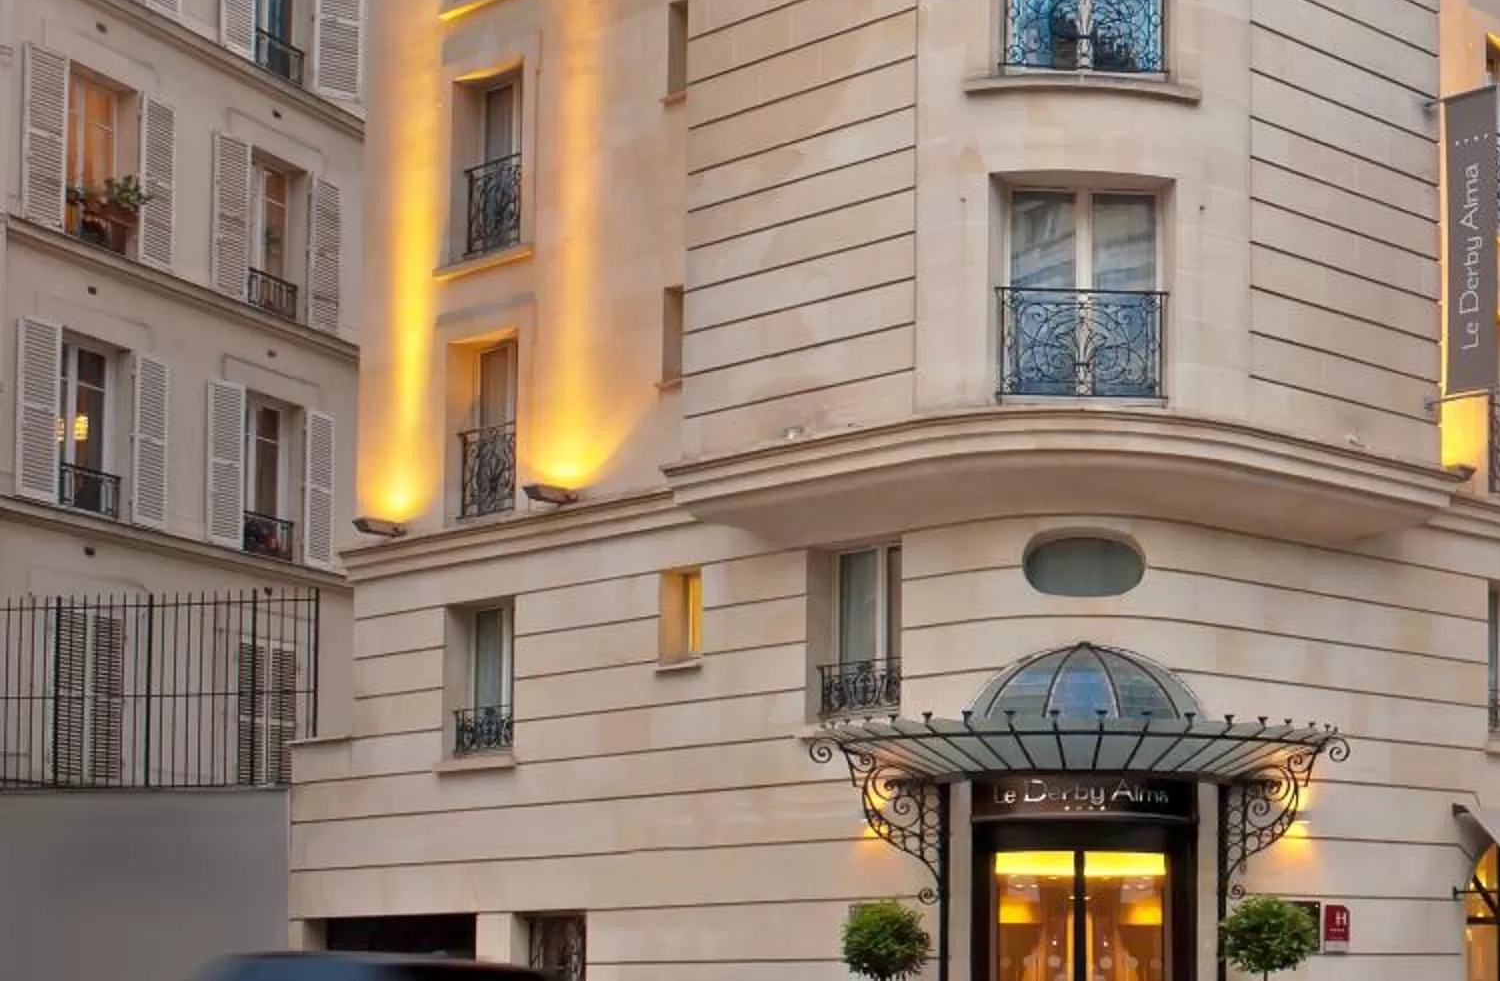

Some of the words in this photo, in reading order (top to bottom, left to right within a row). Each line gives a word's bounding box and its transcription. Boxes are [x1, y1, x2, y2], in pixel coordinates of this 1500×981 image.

[1459, 162, 1480, 231] Alma
[1459, 238, 1484, 316] Derby
[1461, 321, 1480, 351] Le
[993, 783, 1017, 805] Le
[1023, 778, 1106, 806] Derby
[1111, 778, 1169, 805] Alma
